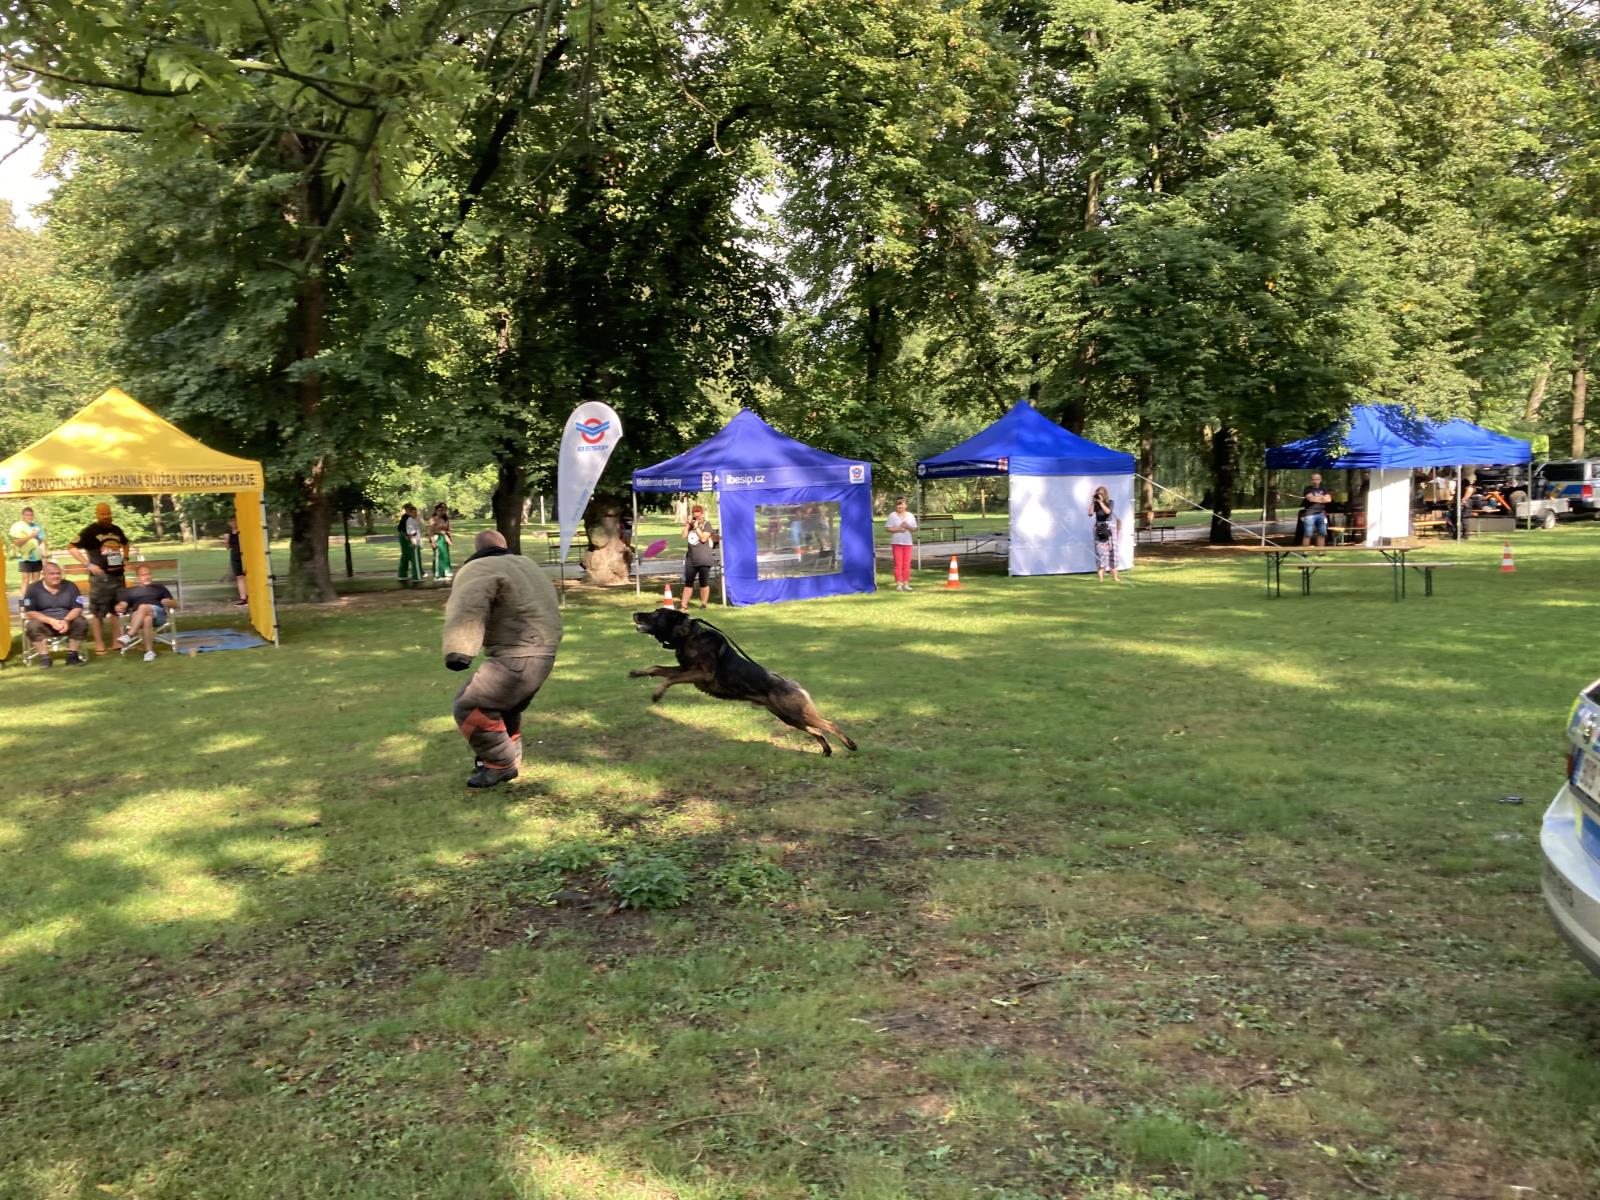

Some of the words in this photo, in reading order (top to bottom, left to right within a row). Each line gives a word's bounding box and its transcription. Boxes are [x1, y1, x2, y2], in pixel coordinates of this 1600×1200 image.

[20, 475, 88, 491] ZDRAVOTNICKÁ
[90, 474, 143, 489] ZÁCHRANNÁ
[145, 472, 177, 487] SLUŽBA
[229, 473, 256, 485] KRAJE
